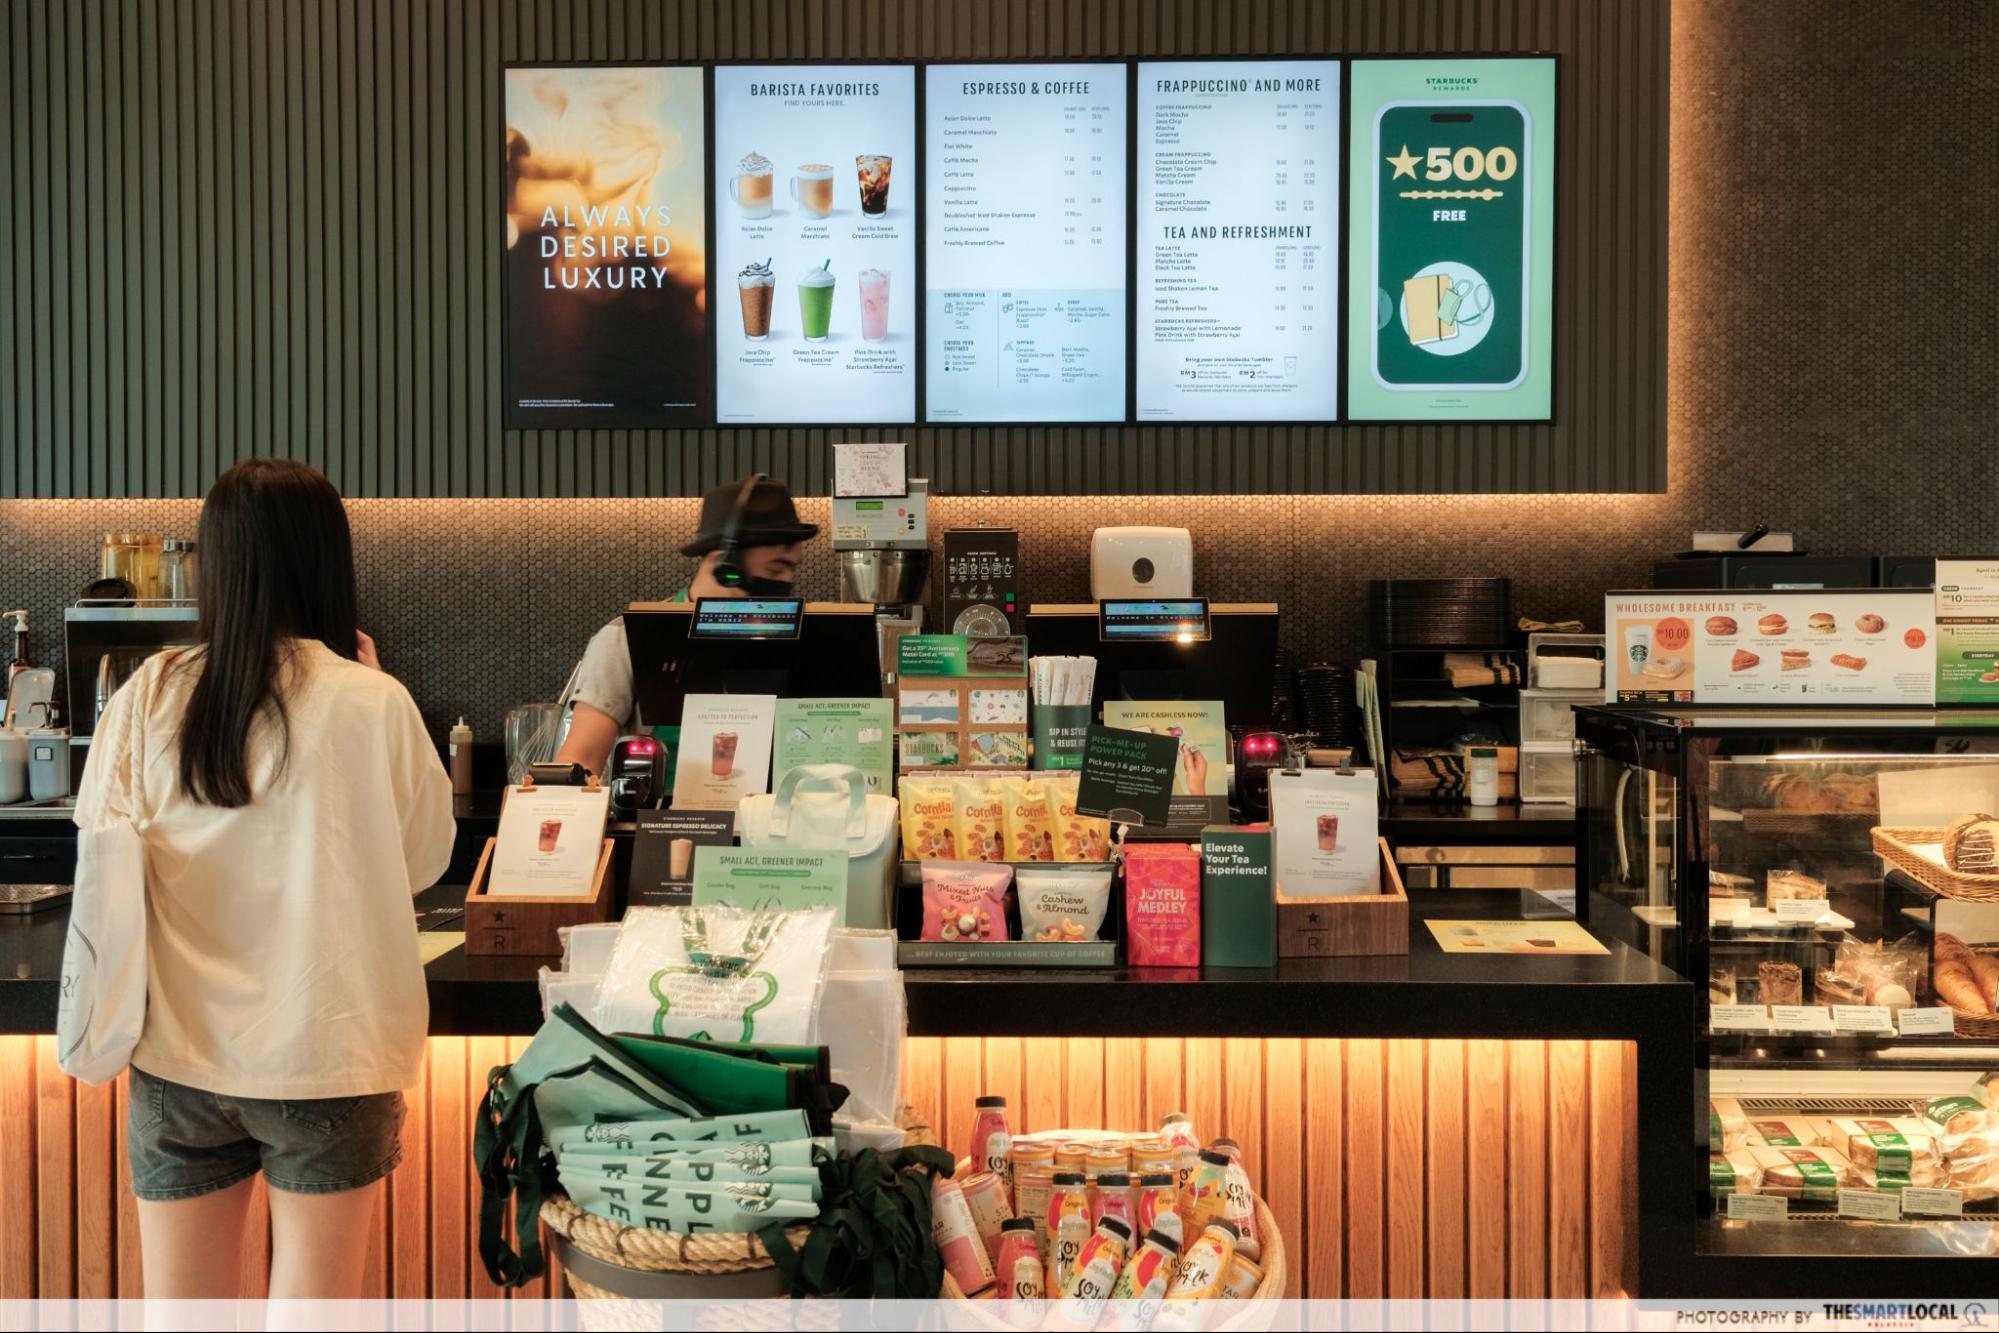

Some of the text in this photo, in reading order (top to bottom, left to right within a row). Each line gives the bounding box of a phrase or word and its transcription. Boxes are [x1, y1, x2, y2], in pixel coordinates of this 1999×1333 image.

[1157, 78, 1321, 92] FRAPPUCCINO AND MORE
[1425, 77, 1479, 85] STARBUCKS
[750, 83, 880, 97] BARISTA FAVORITES
[963, 81, 1090, 95] ESPRESSO & COFFEE
[1425, 146, 1517, 181] 500
[541, 205, 671, 227] ALWAYS
[1433, 210, 1467, 222] FREE
[1164, 225, 1312, 239] TEA AND REFRESHMENT
[541, 235, 671, 258] DESIRED
[544, 266, 668, 289] LUXURY
[1616, 602, 1736, 613] WHOLESOME BREAKFAST
[1048, 727, 1060, 736] SIP
[1061, 727, 1070, 736] IN
[905, 743, 944, 753] STARBUCKS
[1092, 735, 1147, 749] PICK-ME-UP
[1090, 744, 1147, 760] POWER PACK
[1088, 757, 1102, 766] Pick
[1103, 760, 1116, 769] any
[1128, 764, 1140, 772] get
[1206, 843, 1244, 853] Elevate
[720, 855, 743, 865] SMALL
[761, 857, 794, 866] GREENER
[795, 857, 823, 867] IMPACT
[1206, 854, 1250, 864] Your Tea
[1206, 865, 1268, 876] Experience!
[937, 883, 995, 896] Mixed Nuts
[1138, 887, 1186, 901] JOYFUL
[956, 894, 982, 905] Fruits
[1041, 894, 1084, 904] Cashew
[1042, 903, 1089, 915] Almond
[1137, 901, 1187, 913] MEDLEY
[494, 935, 505, 948] R
[1308, 936, 1319, 950] R
